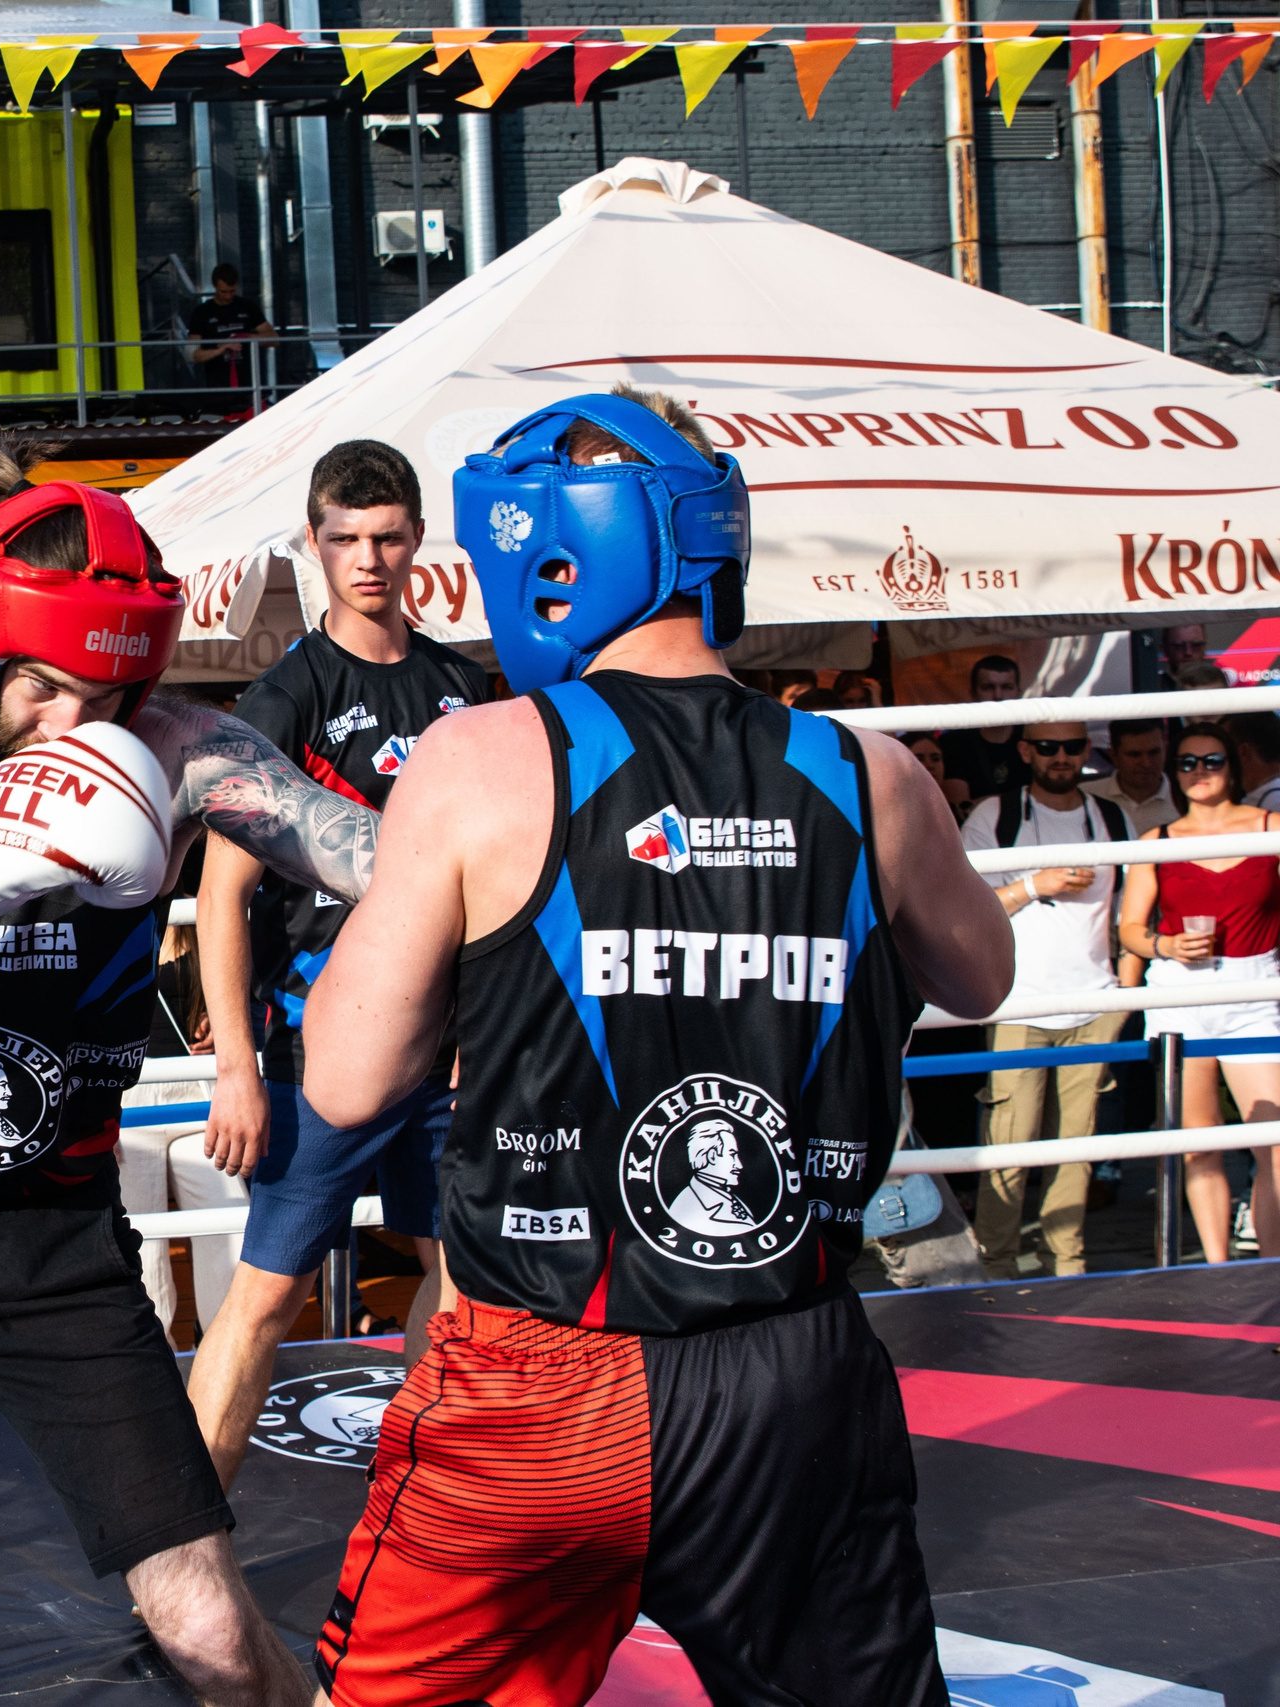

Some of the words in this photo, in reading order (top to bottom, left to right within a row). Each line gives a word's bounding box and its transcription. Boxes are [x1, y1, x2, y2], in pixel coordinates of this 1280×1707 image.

[1065, 405, 1239, 451] 0.0
[812, 574, 869, 593] EST.
[961, 570, 1020, 590] 1581
[85, 627, 151, 657] clinch
[689, 817, 797, 848] БИТВА
[581, 928, 849, 1004] ВЕТРОВ
[496, 1127, 581, 1155] BROOM
[523, 1160, 547, 1172] GIN
[804, 1149, 867, 1180] КРУТ
[509, 1213, 584, 1235] IBSA
[658, 1227, 778, 1259] 2010
